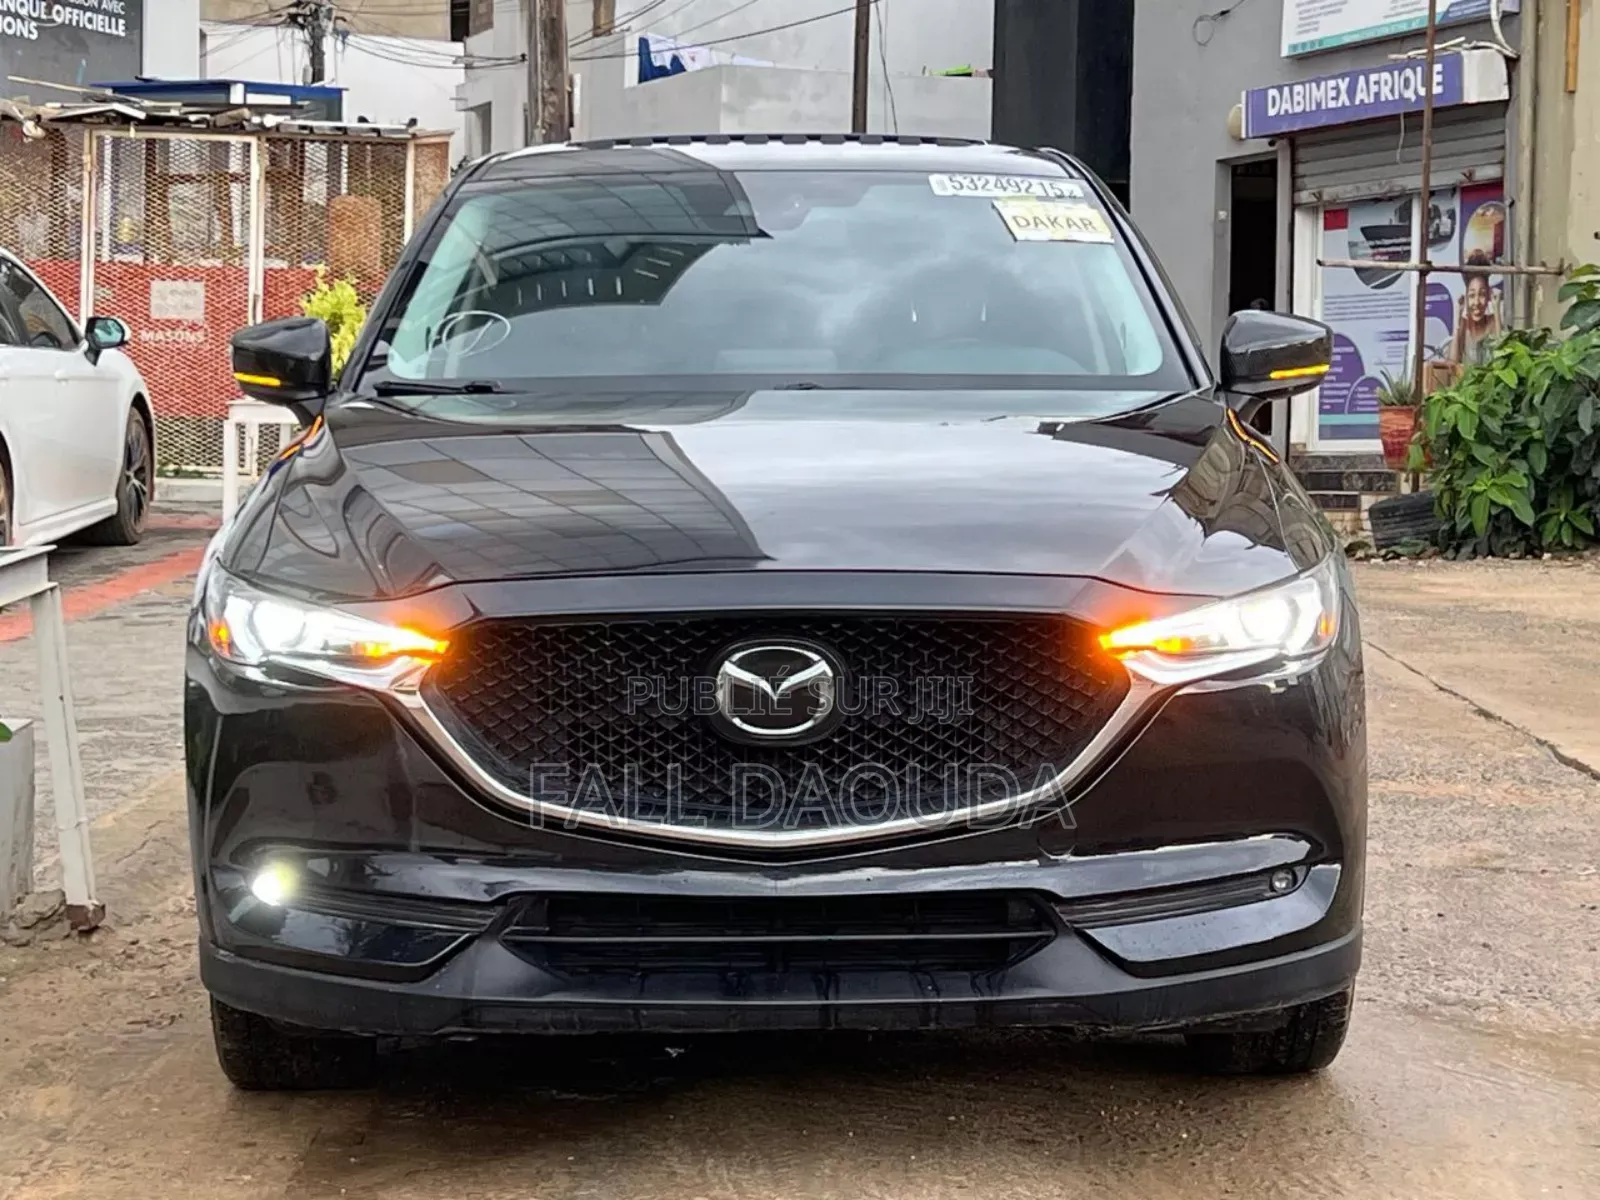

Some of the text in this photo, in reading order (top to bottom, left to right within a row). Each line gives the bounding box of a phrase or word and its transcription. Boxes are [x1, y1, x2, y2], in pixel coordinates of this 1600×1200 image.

[52, 4, 126, 37] OFFICIELLE
[1267, 63, 1443, 117] DABIMEX AFRIQUE
[1012, 214, 1097, 232] DAKAR
